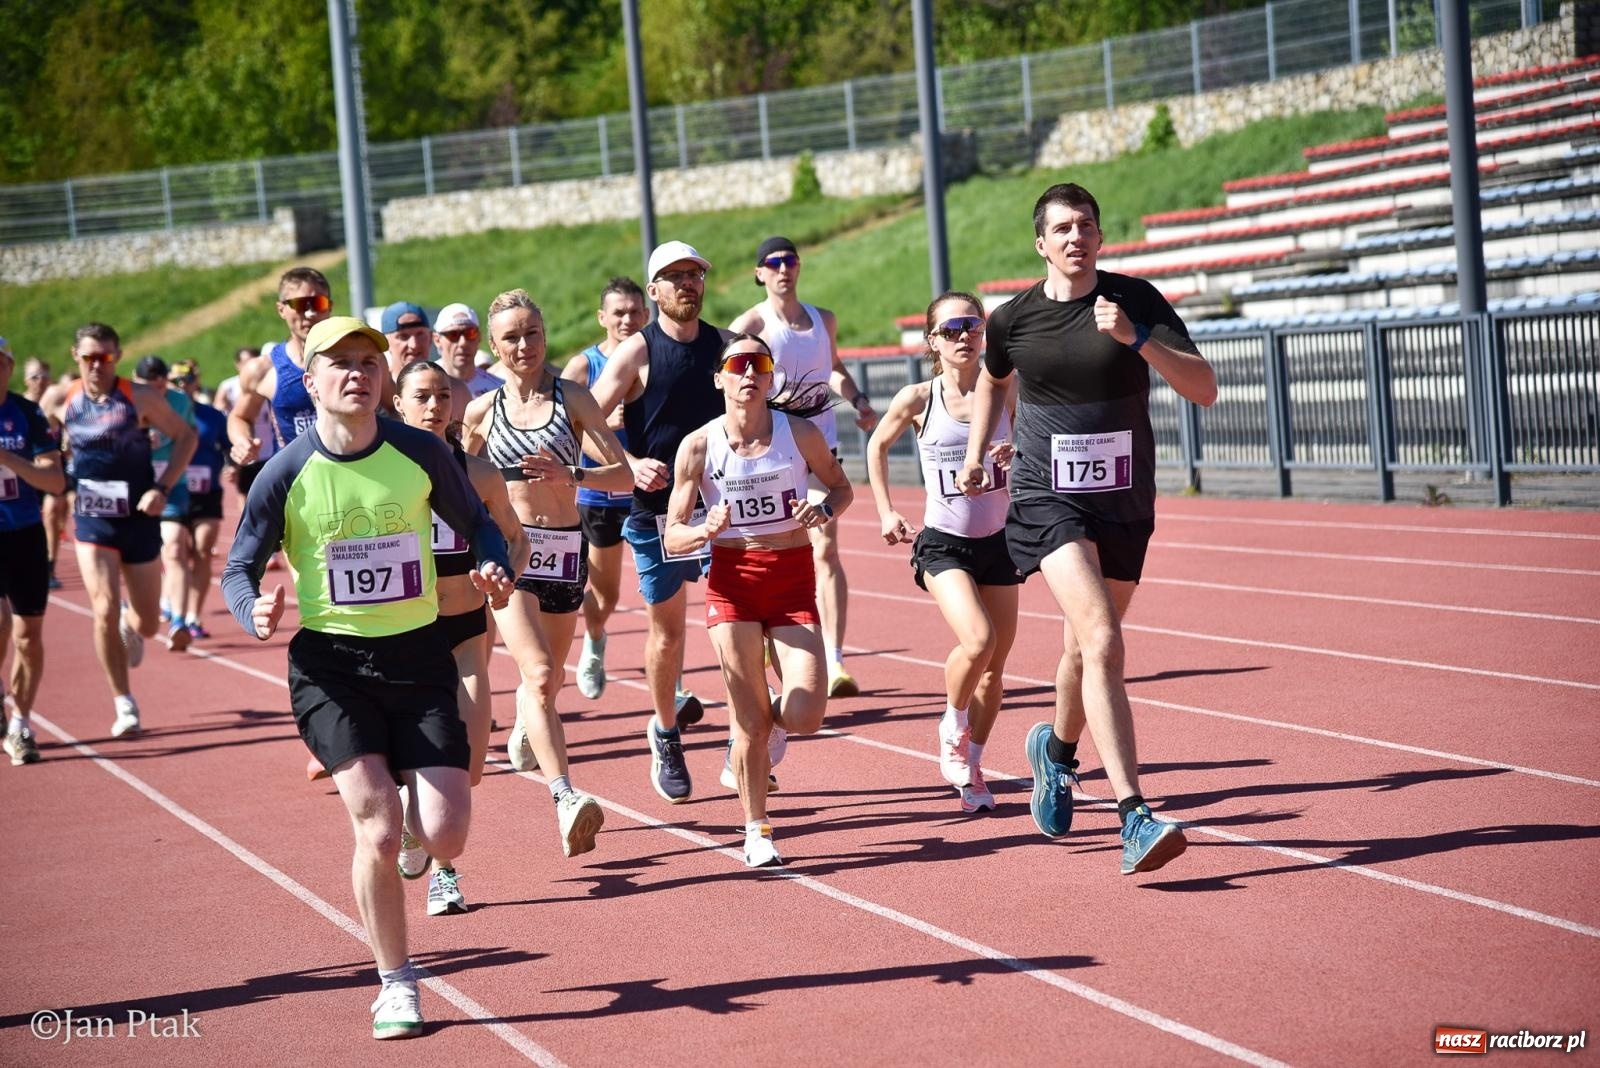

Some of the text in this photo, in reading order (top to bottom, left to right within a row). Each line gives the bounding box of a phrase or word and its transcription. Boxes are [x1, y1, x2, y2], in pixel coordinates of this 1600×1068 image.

[1096, 437, 1116, 445] GRANIC
[1066, 459, 1107, 482] 175
[750, 477, 761, 485] BEZ
[761, 474, 780, 483] GRANIC
[726, 484, 755, 492] 3MAJA2026
[85, 497, 115, 511] 242
[735, 495, 776, 519] 135
[331, 540, 401, 553] XVIII BIEG BEZ GRANIC
[331, 552, 369, 560] 3MAJA2026
[344, 566, 393, 595] 197
